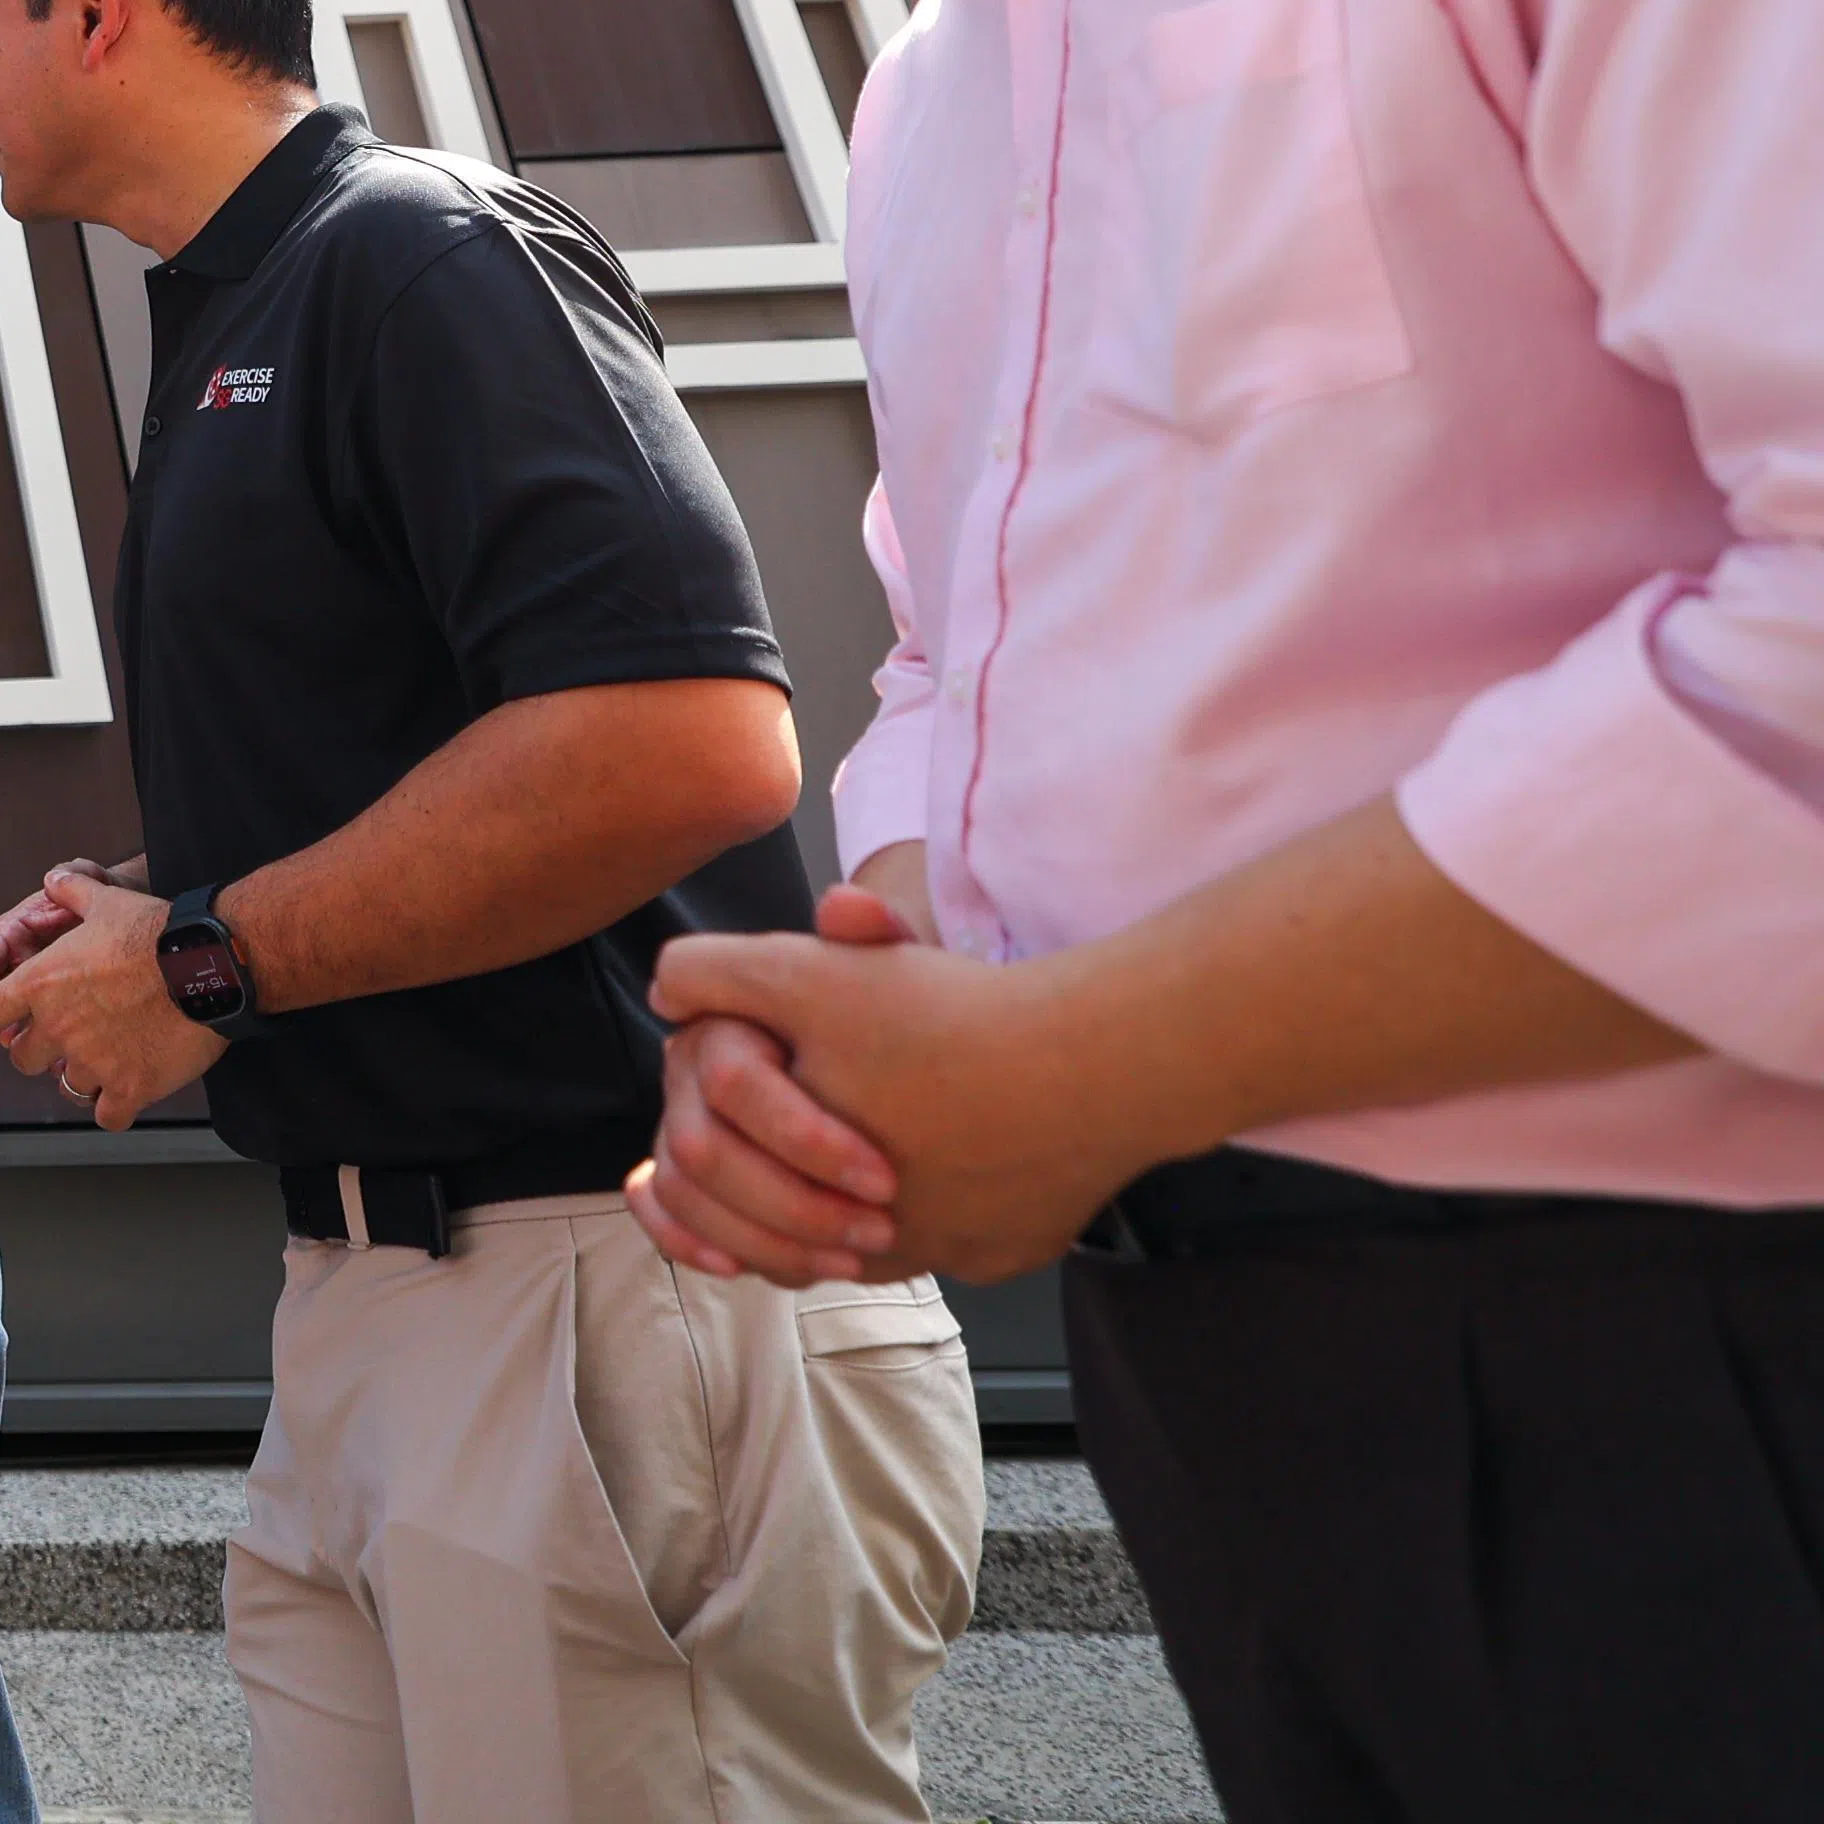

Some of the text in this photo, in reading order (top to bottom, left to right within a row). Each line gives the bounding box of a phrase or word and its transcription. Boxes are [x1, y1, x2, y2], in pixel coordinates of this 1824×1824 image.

[221, 367, 275, 387] EXERCISE
[230, 386, 271, 403] READY
[184, 975, 229, 996] 15:42
